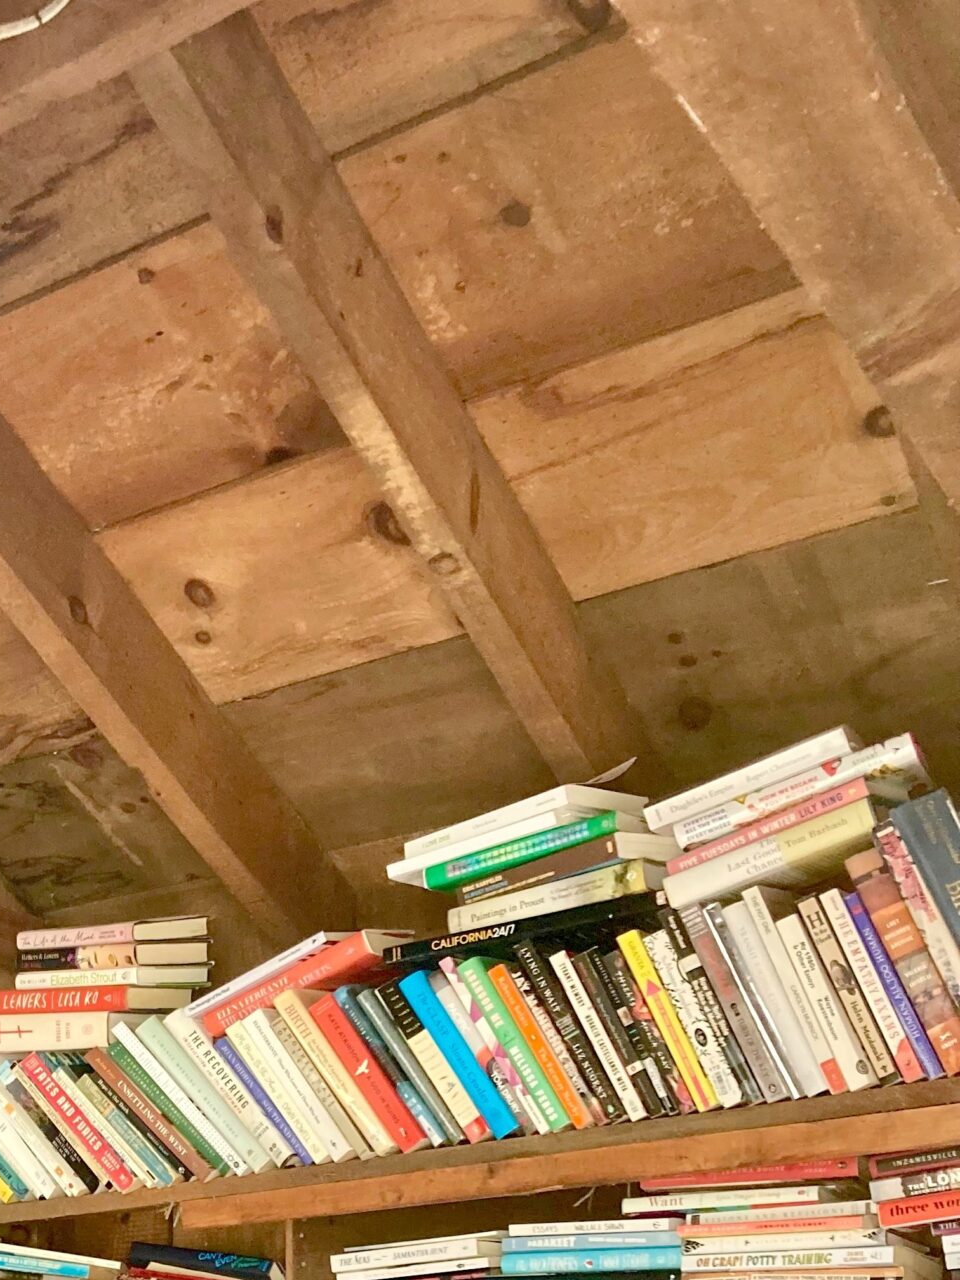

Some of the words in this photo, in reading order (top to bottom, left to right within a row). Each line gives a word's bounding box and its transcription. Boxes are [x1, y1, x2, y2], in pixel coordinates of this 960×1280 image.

[679, 856, 698, 870] FIVE
[700, 835, 745, 861] TUESDAYS
[747, 831, 759, 843] IN
[760, 815, 796, 837] WINTER
[799, 805, 818, 819] LILY
[820, 792, 843, 809] KING
[785, 834, 807, 849] Tom
[753, 843, 781, 861] Good
[727, 857, 752, 873] Last
[745, 856, 785, 875] Chance
[471, 907, 506, 923] Paintings
[508, 905, 517, 913] in
[519, 897, 545, 911] Proust
[806, 912, 824, 928] H
[431, 924, 515, 951] CALIFORNIA24/7
[863, 927, 885, 961] HUMAN
[51, 969, 89, 986] Elizabeth
[90, 972, 117, 983] Strout
[559, 963, 573, 986] TYRANT
[835, 912, 853, 939] THE
[846, 942, 879, 994] EMPATHY
[873, 997, 900, 1039] EXAMS
[3, 992, 47, 1009] LEAVERS
[58, 991, 82, 1007] LISA
[84, 991, 99, 1005] KO
[823, 997, 835, 1017] Wayne
[283, 1004, 314, 1041] BIRTH
[519, 947, 539, 976] LYING
[537, 976, 548, 989] IN
[543, 986, 561, 1012] WAIT
[572, 1043, 586, 1066] LIZ
[581, 1063, 607, 1100] NUGENT
[187, 1029, 205, 1055] THE
[203, 1049, 249, 1110] RECOVERING
[489, 1008, 504, 1030] ME
[508, 1044, 540, 1086] MELISSA
[537, 1085, 560, 1122] FEBOS
[490, 1072, 502, 1089] TOM
[500, 1087, 521, 1114] DRURY
[32, 1065, 60, 1097] FATES
[56, 1092, 76, 1117] AND
[70, 1113, 102, 1151] FURIES
[155, 1121, 168, 1137] THE
[166, 1132, 187, 1156] WEST
[648, 1197, 684, 1207] Want
[890, 1198, 930, 1217] three
[697, 1256, 710, 1267] OH
[746, 1255, 777, 1266] POTTY
[781, 1253, 833, 1265] TRAINING
